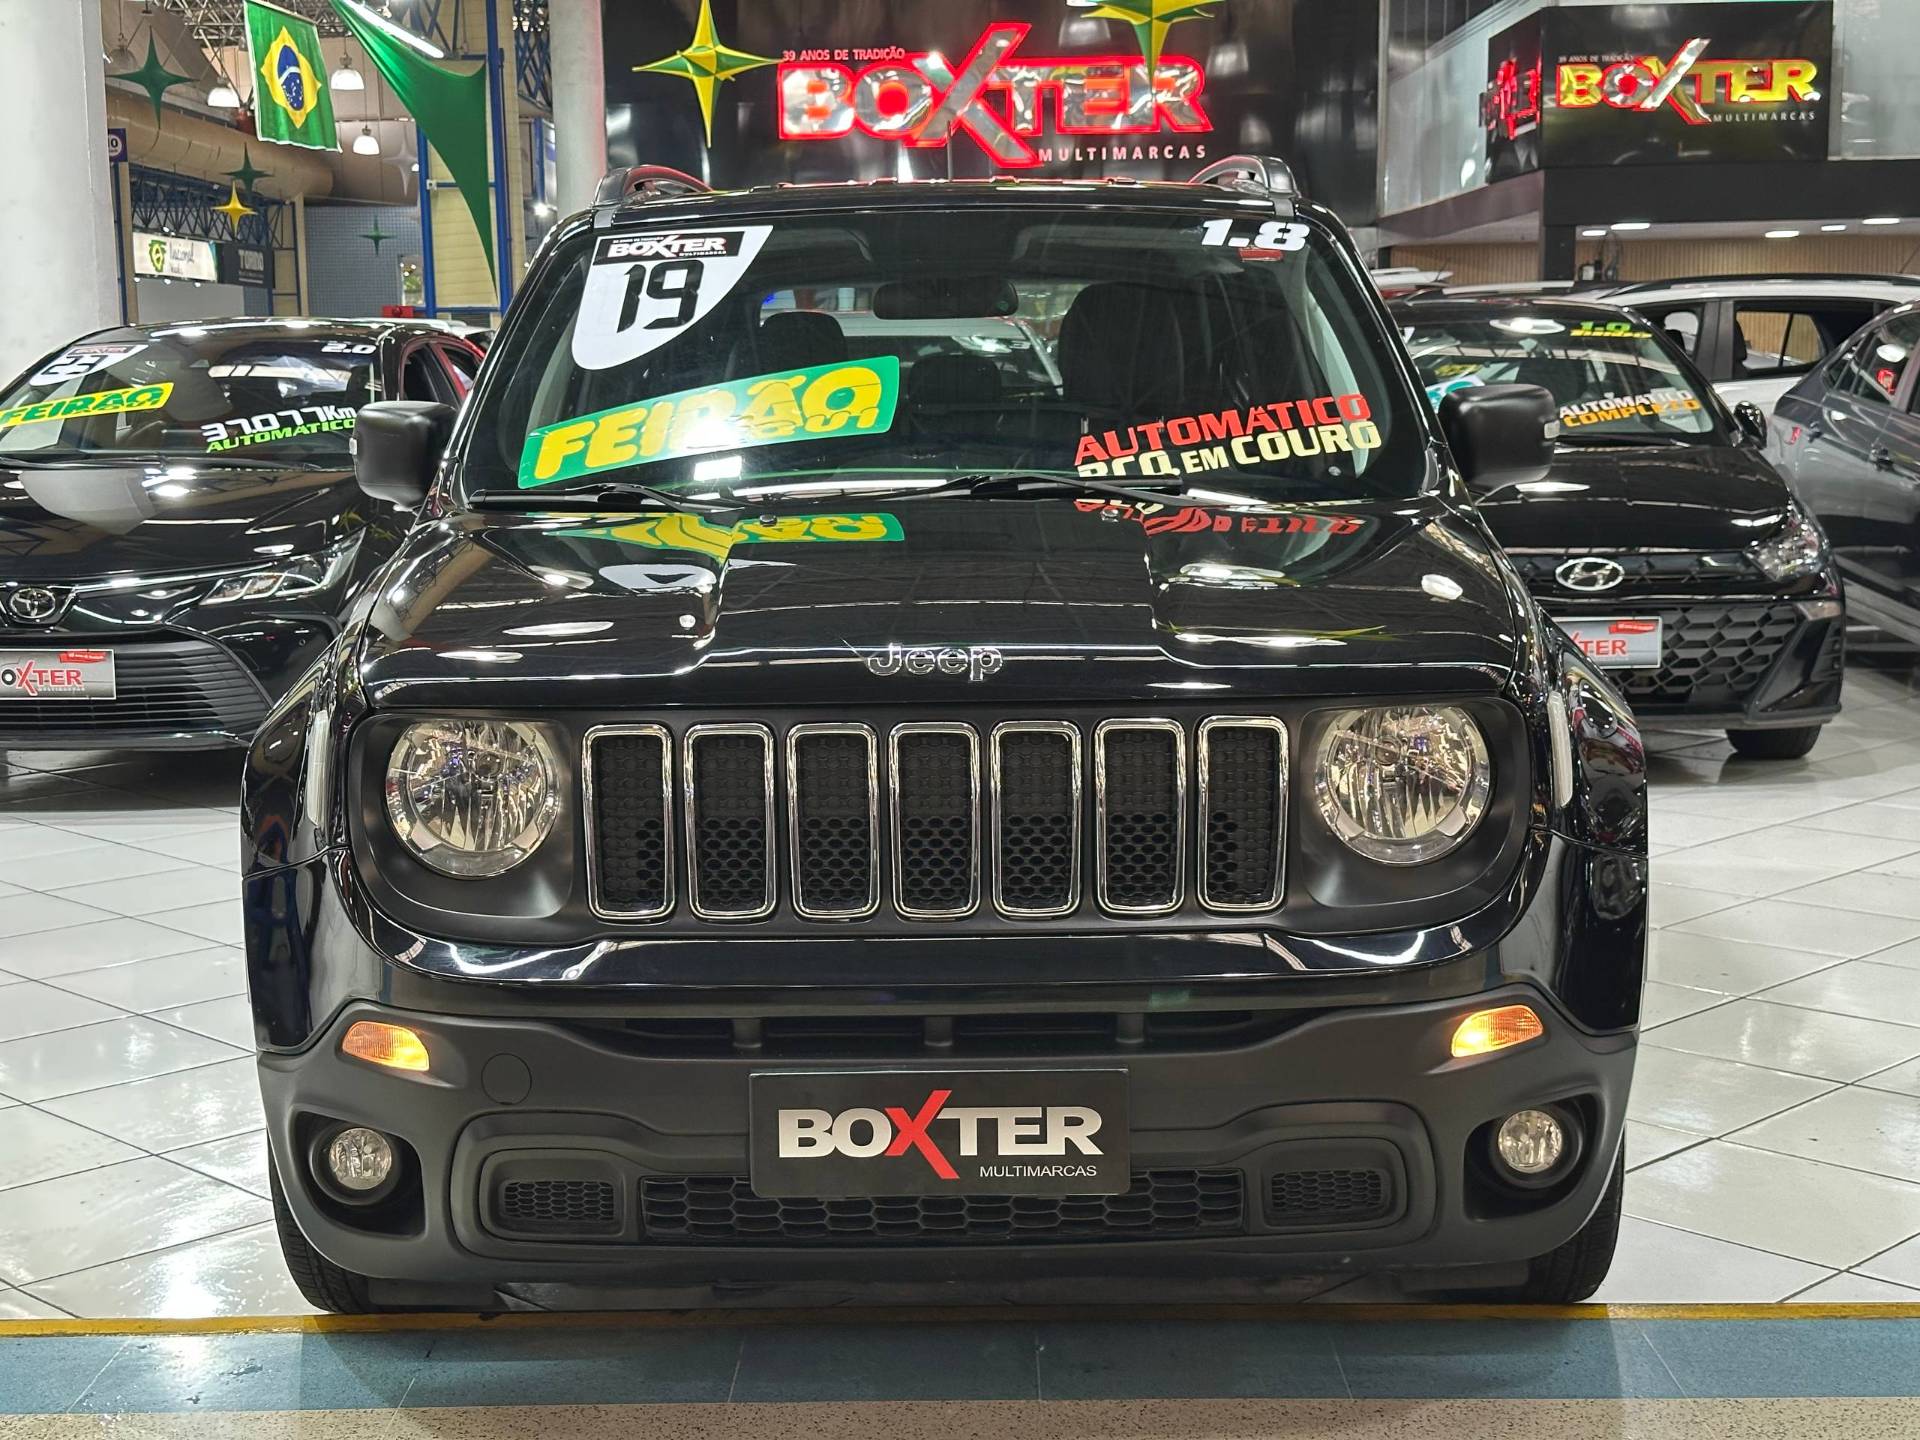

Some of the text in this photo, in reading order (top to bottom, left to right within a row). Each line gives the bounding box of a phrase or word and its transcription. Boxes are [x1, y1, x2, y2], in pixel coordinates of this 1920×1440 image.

[782, 46, 905, 61] 39 ANOS DE TRADIÇÃO
[777, 23, 1214, 168] BOXTER
[1556, 37, 1821, 125] BOXTER
[1714, 112, 1815, 122] MULTIMARCAS
[1039, 145, 1206, 162] MULTIMARCAS
[607, 235, 727, 258] BOXTER
[1201, 219, 1310, 251] 1.8
[617, 259, 704, 334] 19
[1580, 321, 1632, 332] 1.0
[321, 341, 377, 354] 2.0
[1184, 446, 1229, 474] EM
[1231, 420, 1383, 466] COURO
[0, 660, 83, 696] OXTER
[865, 642, 1003, 682] Jeep
[778, 1089, 1105, 1180] BOXTER
[979, 1165, 1097, 1178] MULTIMARCAS
